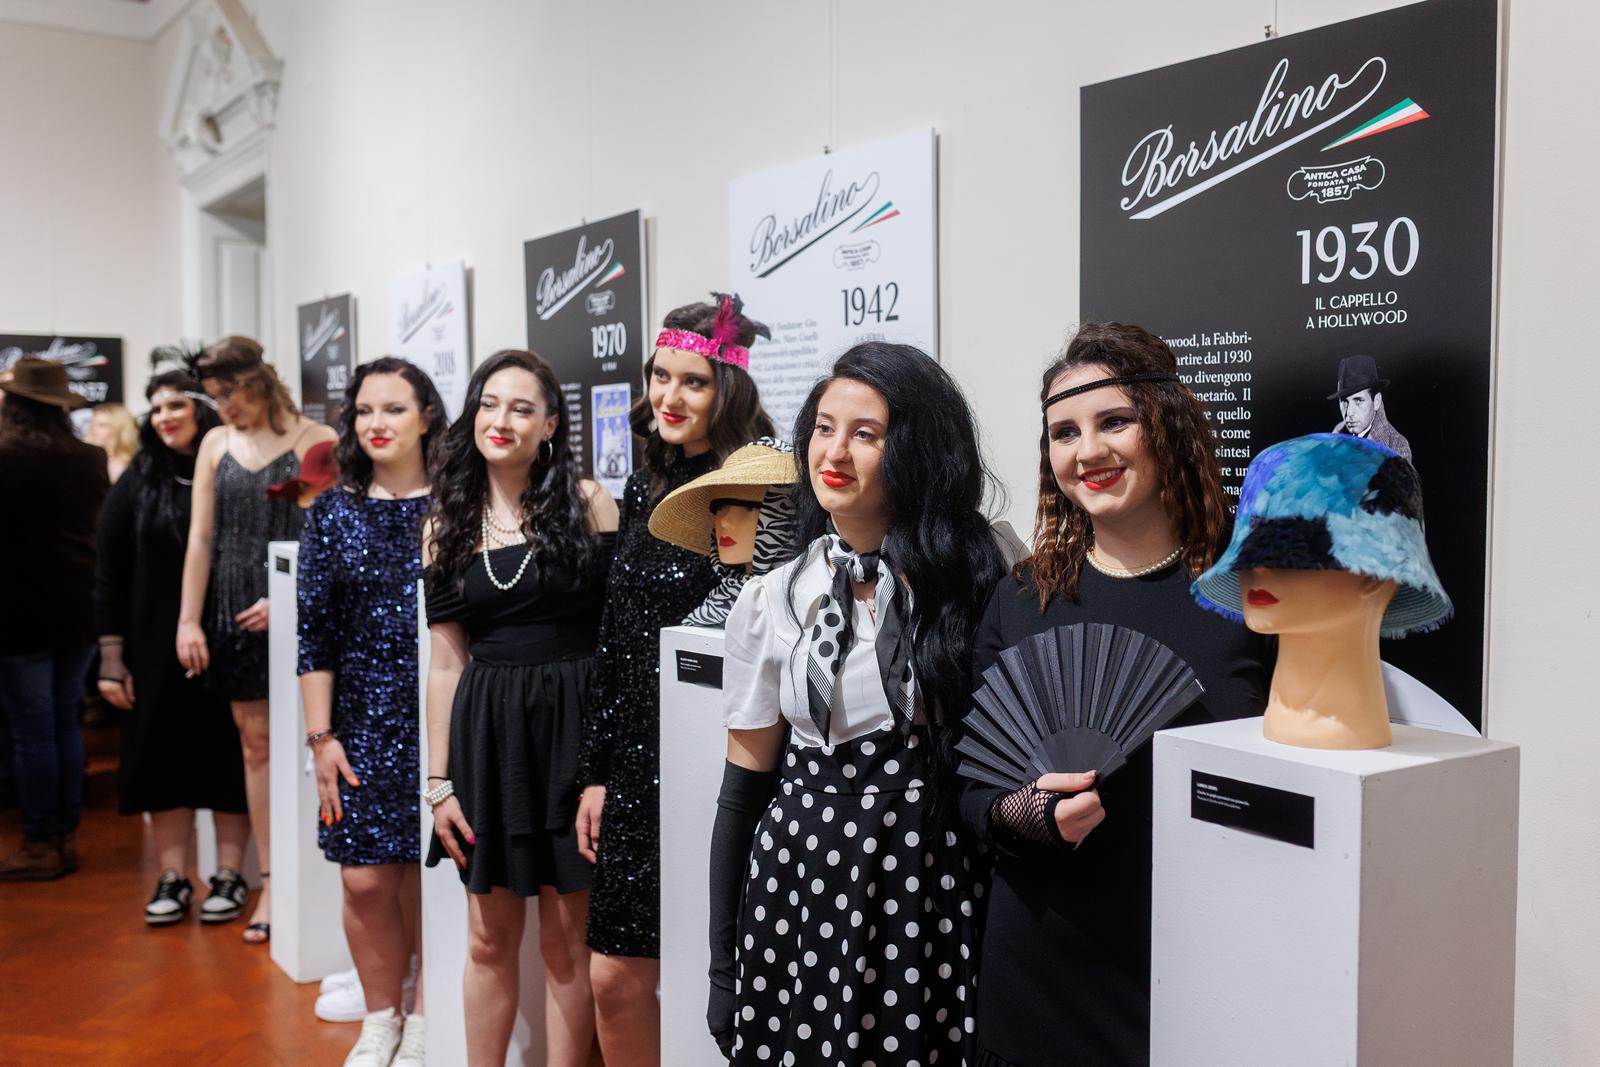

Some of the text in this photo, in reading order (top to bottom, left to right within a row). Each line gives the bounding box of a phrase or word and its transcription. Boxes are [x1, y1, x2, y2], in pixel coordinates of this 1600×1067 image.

[1120, 56, 1387, 219] Borsalino
[1304, 163, 1367, 181] ANTICA CASA
[1307, 174, 1362, 188] FONDATA NEL
[1321, 185, 1349, 198] 1857
[751, 169, 880, 278] Borsalino
[1296, 216, 1420, 285] 1930
[842, 281, 899, 326] 1942
[1315, 290, 1398, 310] IL CAPPELLO
[1305, 309, 1408, 329] A HOLLYWOOD
[591, 322, 627, 358] 1970
[1201, 333, 1211, 346] la
[1213, 331, 1252, 345] Fabbri-
[1203, 351, 1220, 364] dal
[1223, 350, 1252, 363] 1930
[1194, 370, 1251, 386] divengono
[1243, 388, 1251, 401] Il
[1216, 407, 1251, 424] quello
[1221, 429, 1251, 439] come
[1215, 445, 1250, 458] sintesi
